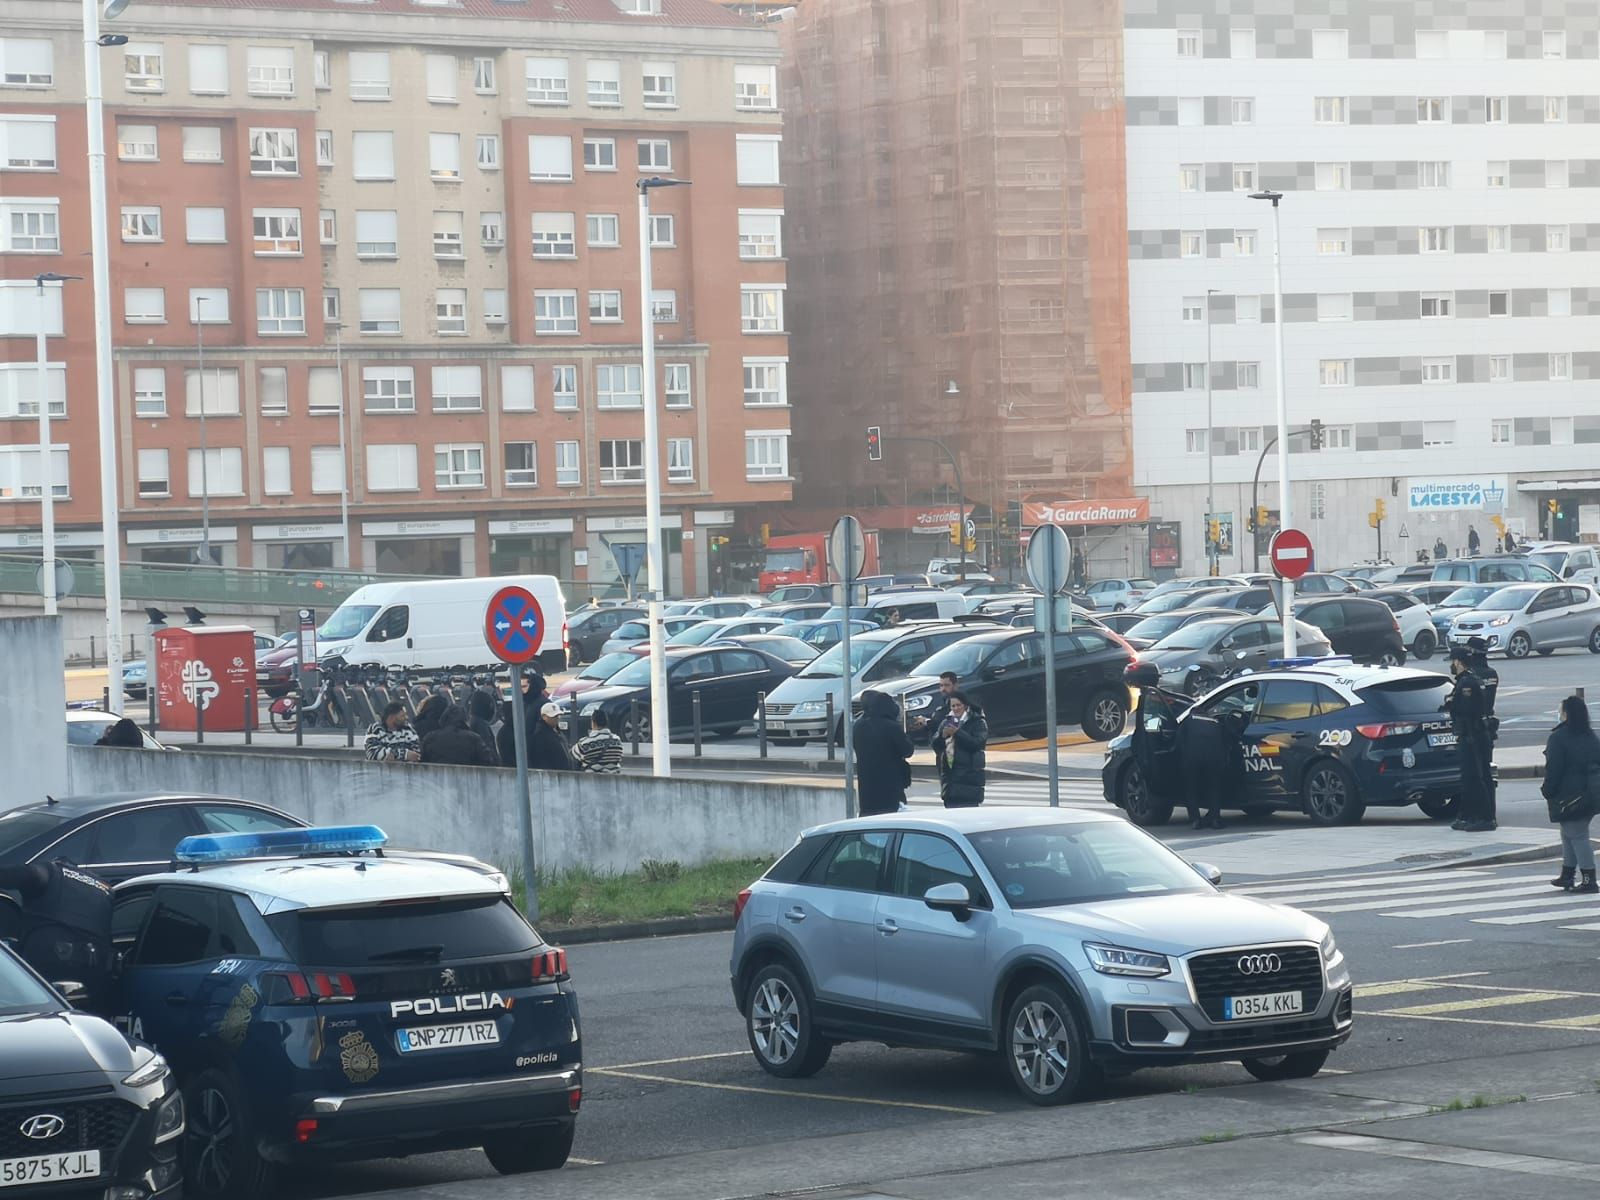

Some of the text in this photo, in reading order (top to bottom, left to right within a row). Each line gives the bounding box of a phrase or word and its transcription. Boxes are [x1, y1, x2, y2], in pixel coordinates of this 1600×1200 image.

[1411, 483, 1480, 493] multimercado
[1422, 720, 1453, 731] POLIC
[1235, 994, 1298, 1015] 0354 KKL
[3, 1154, 94, 1181] 5875 KJL
